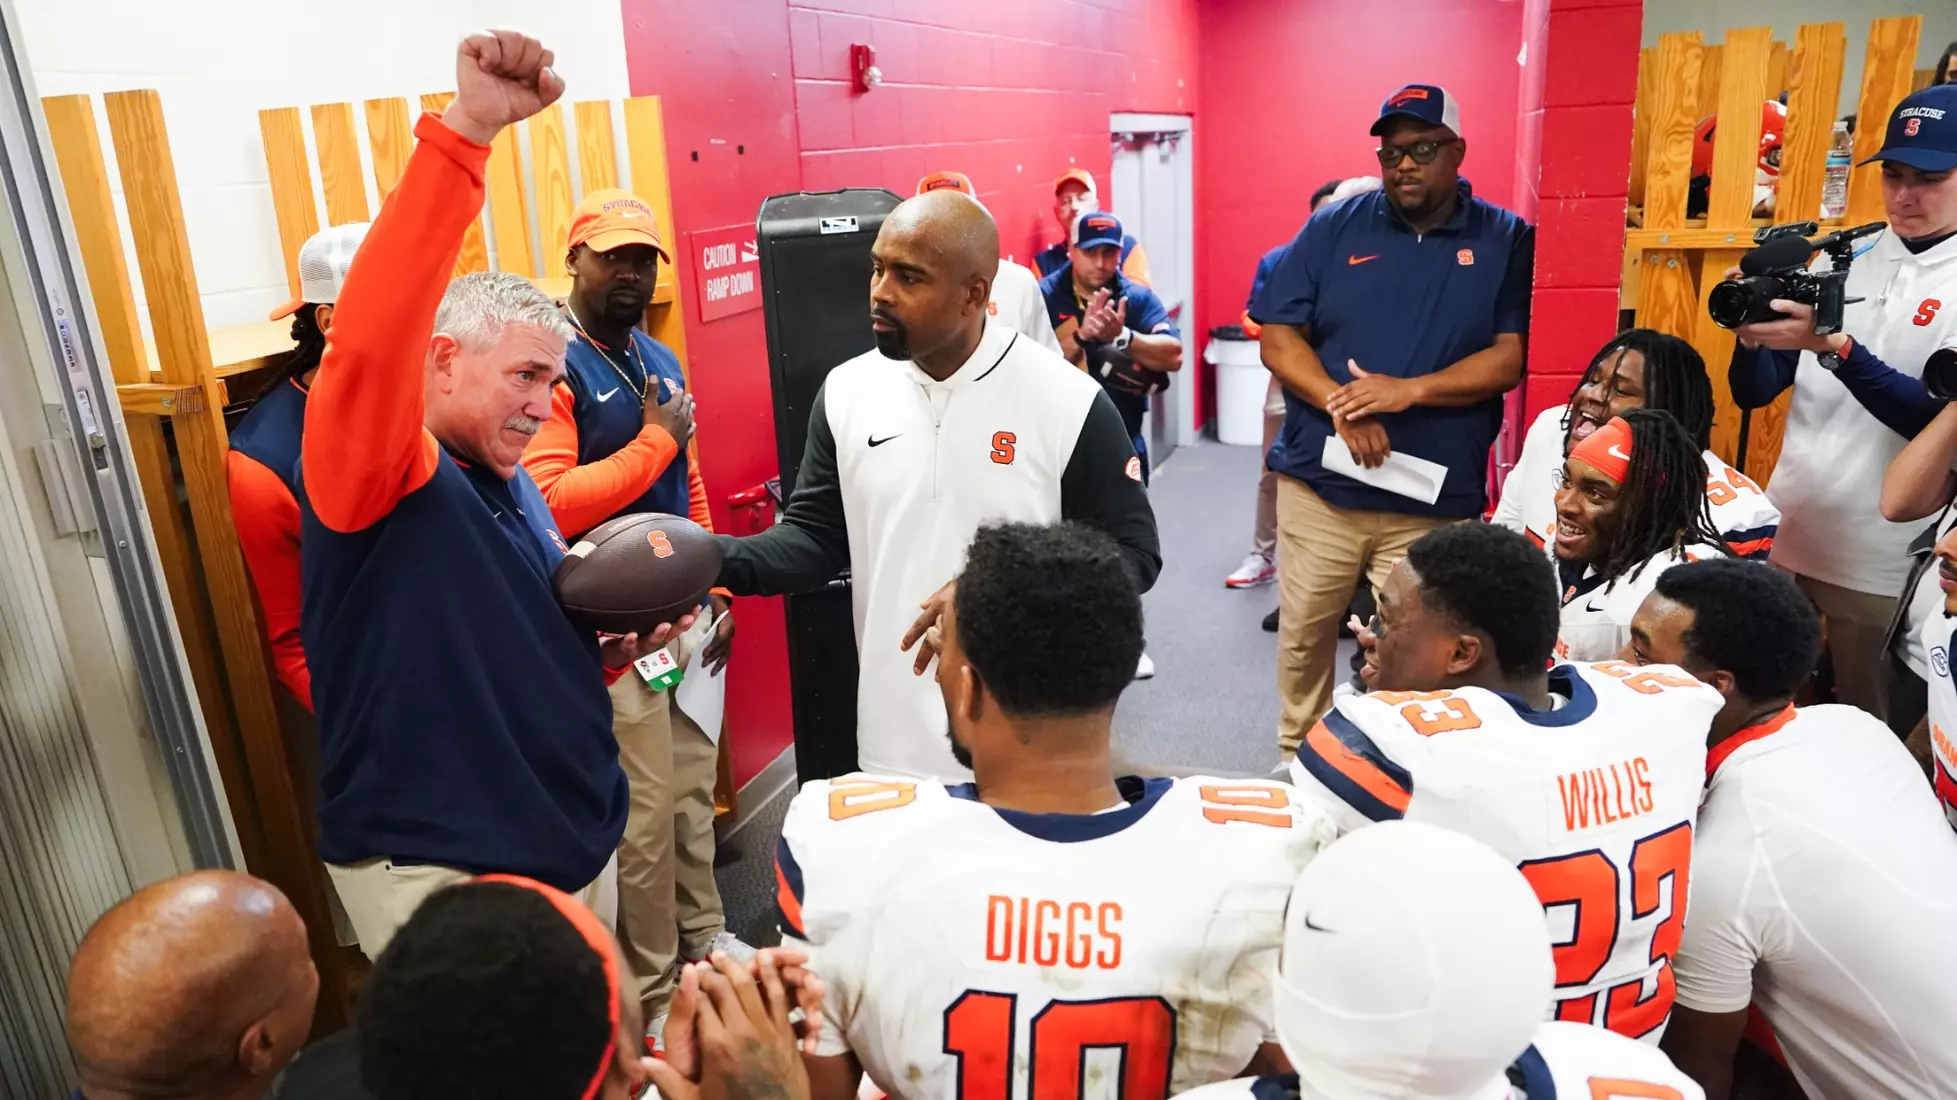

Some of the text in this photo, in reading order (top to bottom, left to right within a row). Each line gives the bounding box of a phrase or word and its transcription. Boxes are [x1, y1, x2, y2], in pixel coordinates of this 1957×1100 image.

[1899, 106, 1947, 120] SYRACUSE
[1904, 118, 1921, 137] S
[703, 242, 737, 271] CAUTION
[1457, 249, 1475, 266] S
[706, 270, 754, 302] RAMP DOWN
[1912, 298, 1942, 327] S
[990, 430, 1017, 465] S
[646, 530, 672, 558] S
[658, 652, 670, 666] S
[1199, 785, 1293, 829] 10
[1557, 757, 1655, 832] WILLIS
[985, 894, 1123, 971] DIGGS
[1516, 819, 1692, 1041] 23
[942, 988, 1178, 1100] 10
